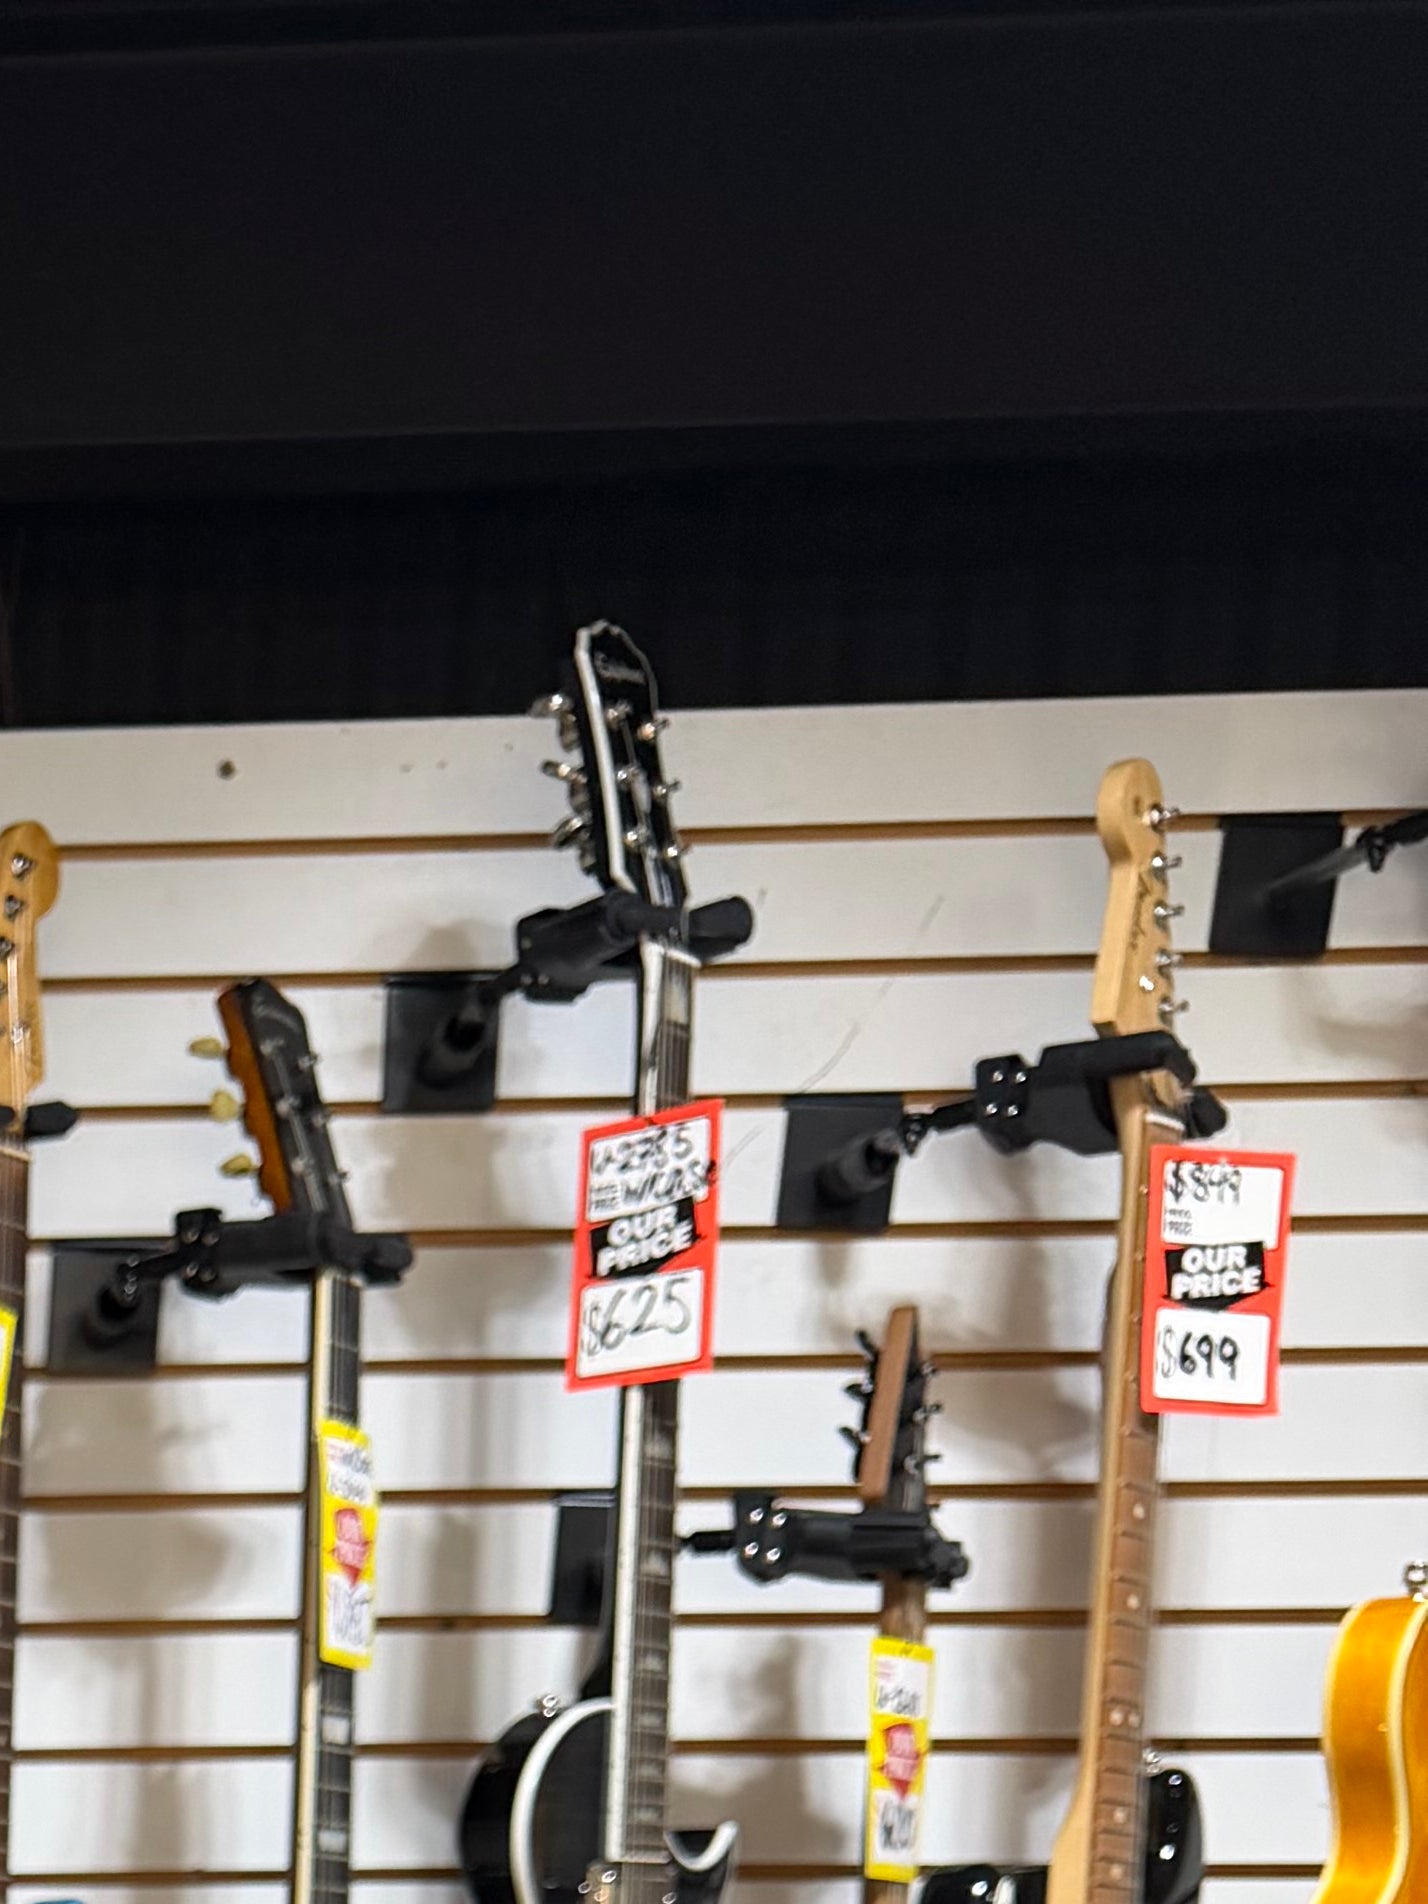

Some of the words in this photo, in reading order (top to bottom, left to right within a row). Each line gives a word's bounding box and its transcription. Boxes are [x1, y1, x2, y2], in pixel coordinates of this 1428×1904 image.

[596, 1222, 694, 1278] PRICE
[607, 1204, 681, 1248] OUR
[1170, 1266, 1262, 1300] PRICE
[1180, 1244, 1248, 1274] OUR
[582, 1277, 692, 1357] $625
[1157, 1325, 1241, 1382] $699
